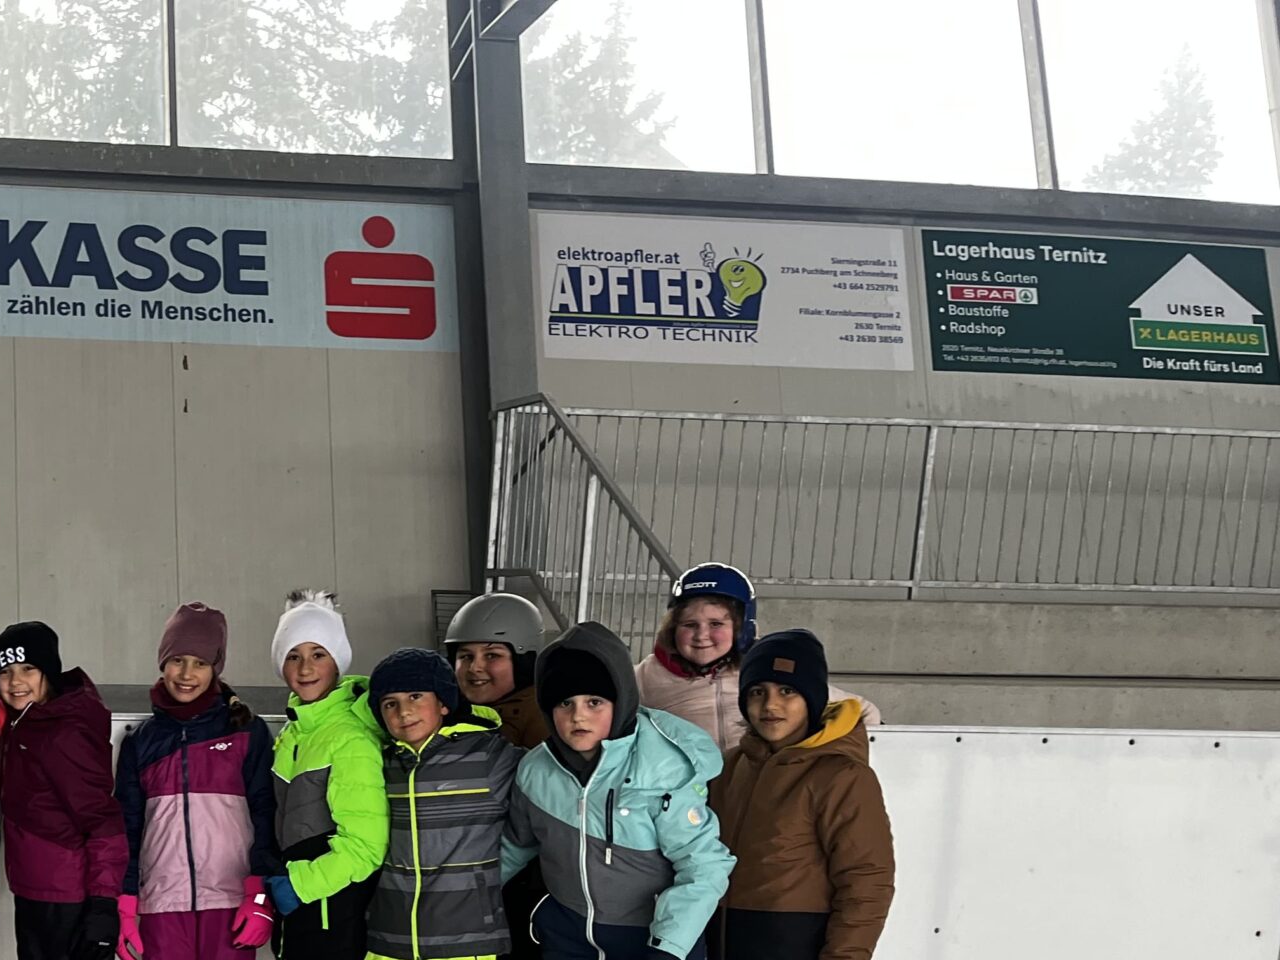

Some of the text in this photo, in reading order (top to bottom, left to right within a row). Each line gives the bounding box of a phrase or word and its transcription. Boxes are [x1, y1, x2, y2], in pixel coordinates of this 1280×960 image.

[557, 248, 681, 266] elektroapfler.at
[932, 240, 1108, 265] Lagerhaus Ternitz
[888, 259, 898, 267] 11
[801, 267, 838, 278] Puchberg
[945, 269, 1038, 284] Haus & Garten
[550, 263, 716, 317] APFLER
[833, 282, 847, 290] +43
[849, 283, 864, 291] 664
[962, 288, 1016, 300] SPAR
[7, 294, 86, 317] zählen
[95, 299, 132, 319] die
[141, 300, 274, 324] Menschen.
[895, 311, 901, 319] 2
[948, 304, 1009, 318] Baustoffe
[1167, 303, 1225, 318] UNSER
[548, 323, 758, 344] ELEKTRO TECHNIK
[875, 323, 901, 332] Ternitz
[950, 322, 1006, 336] Radshop
[839, 335, 854, 343] +43
[1155, 328, 1260, 346] LAGERHAUS
[1142, 356, 1264, 375] Die Kraft fürs Land
